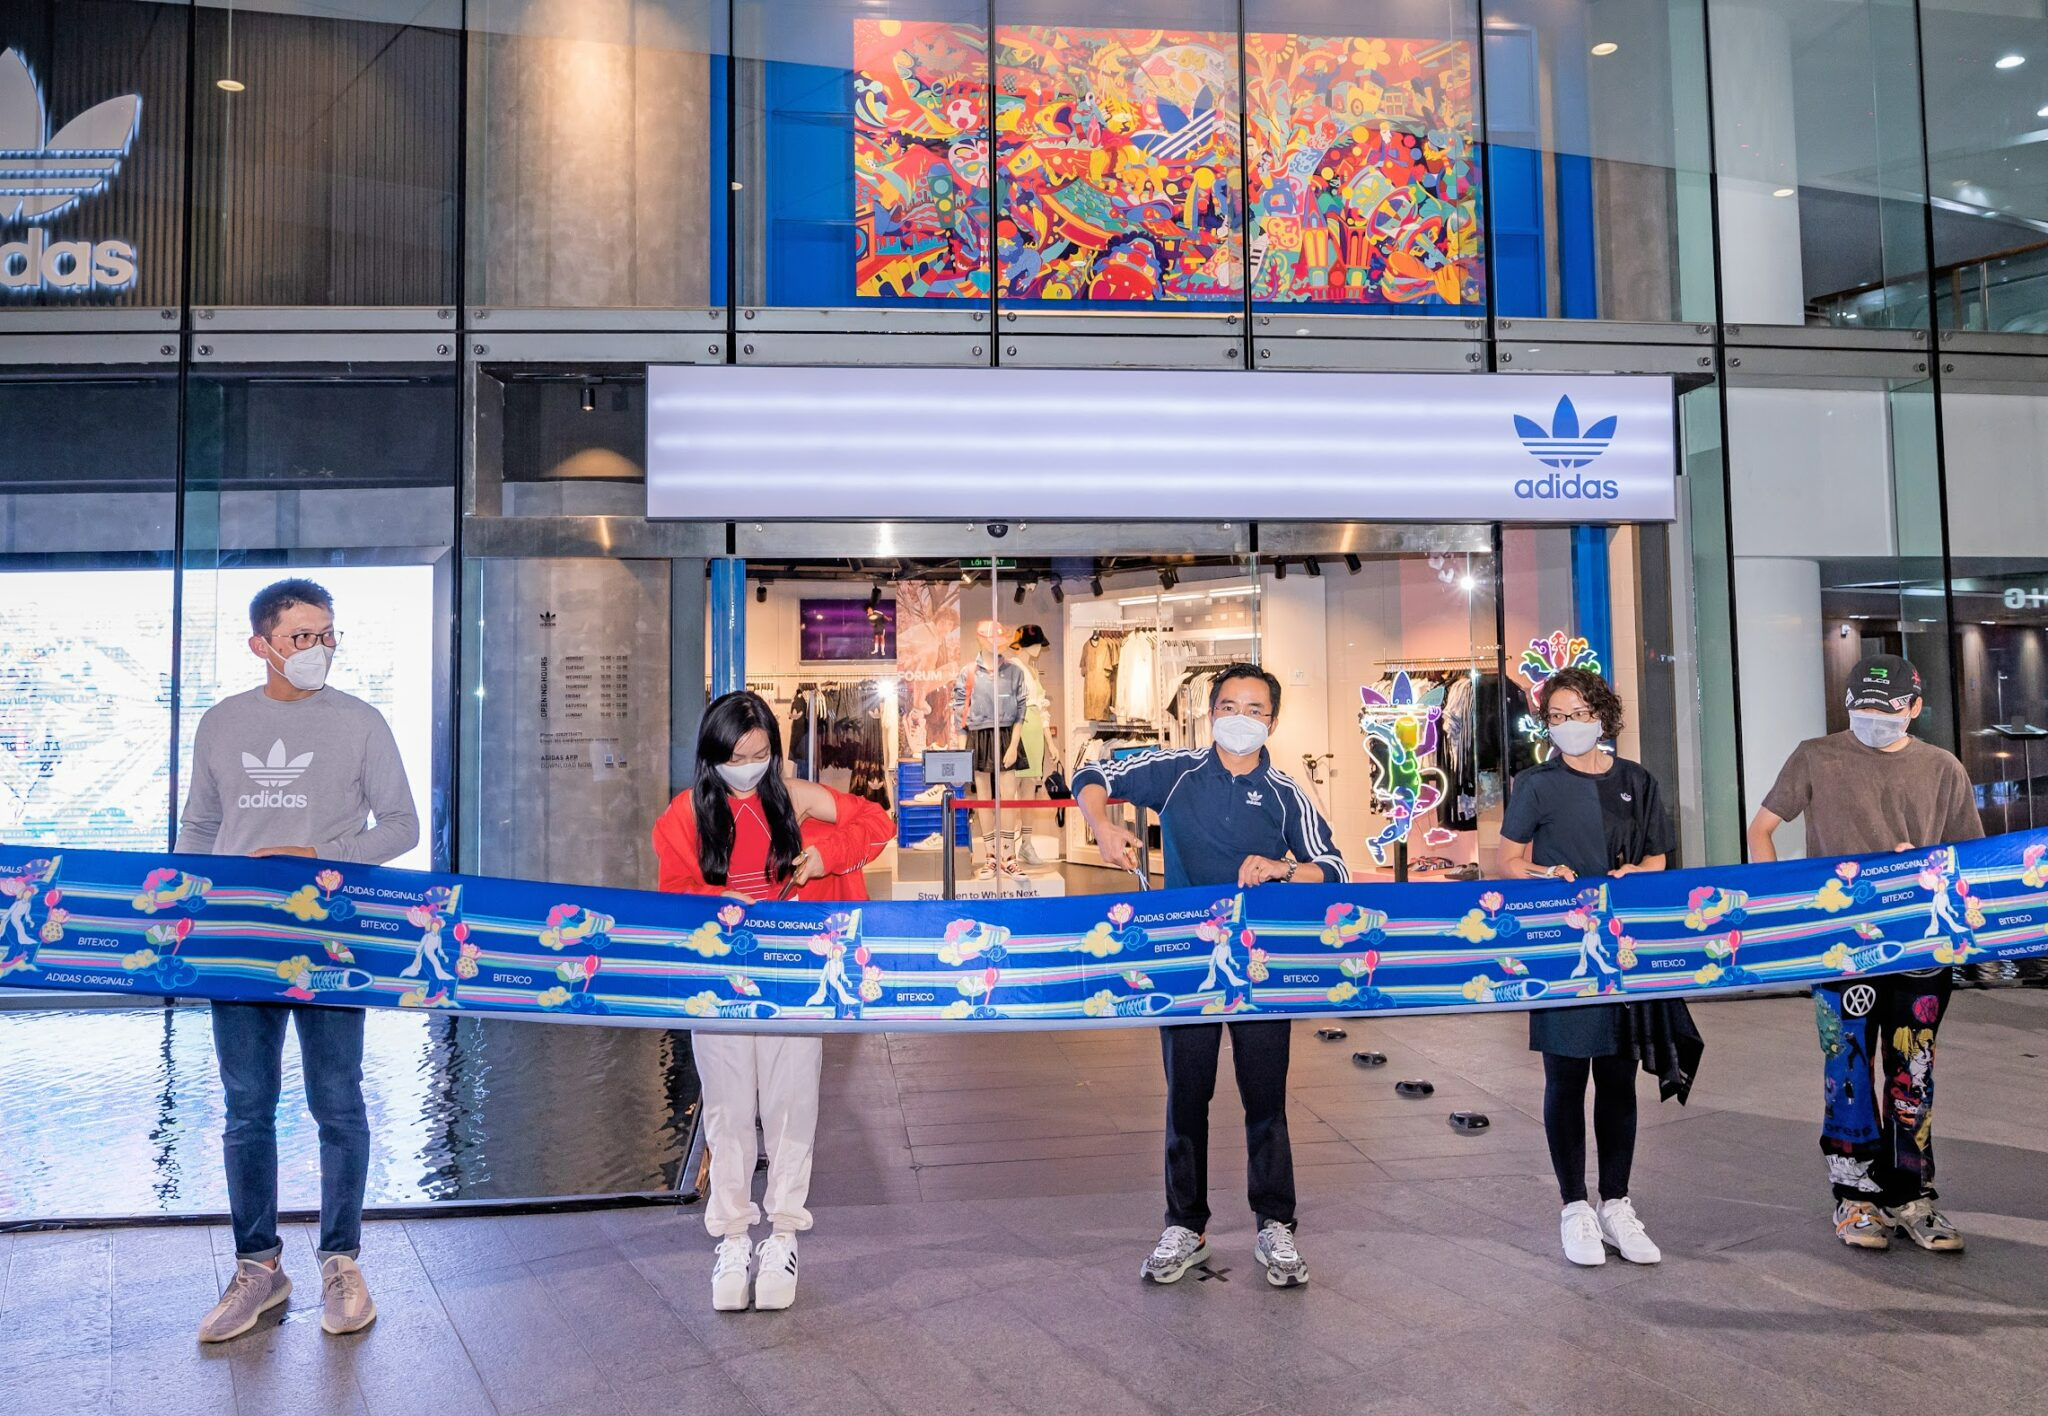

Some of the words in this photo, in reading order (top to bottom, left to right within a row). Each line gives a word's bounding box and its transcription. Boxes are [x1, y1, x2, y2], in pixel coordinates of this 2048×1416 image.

[0, 228, 134, 286] das
[1514, 473, 1619, 500] adidas
[540, 656, 548, 682] HOURS
[897, 671, 942, 682] FORUM
[540, 683, 548, 718] OPENING
[238, 789, 308, 809] adidas
[1861, 865, 1890, 877] ADIDAS
[1889, 859, 1929, 873] ORIGINALS
[342, 885, 375, 896] ADIDAS
[376, 889, 424, 902] ORIGINALS
[918, 892, 940, 901] Stay
[1016, 890, 1040, 898] Next.
[1881, 890, 1914, 904] BITEXCO
[1504, 900, 1535, 911] ADIDAS
[1535, 897, 1577, 909] ORIGINALS
[1133, 912, 1165, 923] ADIDAS
[1165, 909, 1210, 921] ORIGINALS
[1998, 914, 2032, 926] BITEXCO
[360, 919, 399, 931] BITEXCO
[743, 919, 776, 929] ADIDAS
[777, 920, 824, 931] ORIGINALS
[1526, 929, 1561, 940] BITEXCO
[78, 937, 119, 947] BITEXCO
[1154, 942, 1191, 953] BITEXCO
[763, 952, 802, 962] BITEXCO
[1651, 959, 1686, 968] BITEXCO
[45, 972, 82, 983] ADIDAS
[83, 975, 134, 986] ORIGINALS
[493, 973, 532, 985] BITEXCO
[1283, 973, 1320, 983] BITEXCO
[896, 992, 935, 1002] BITEXCO
